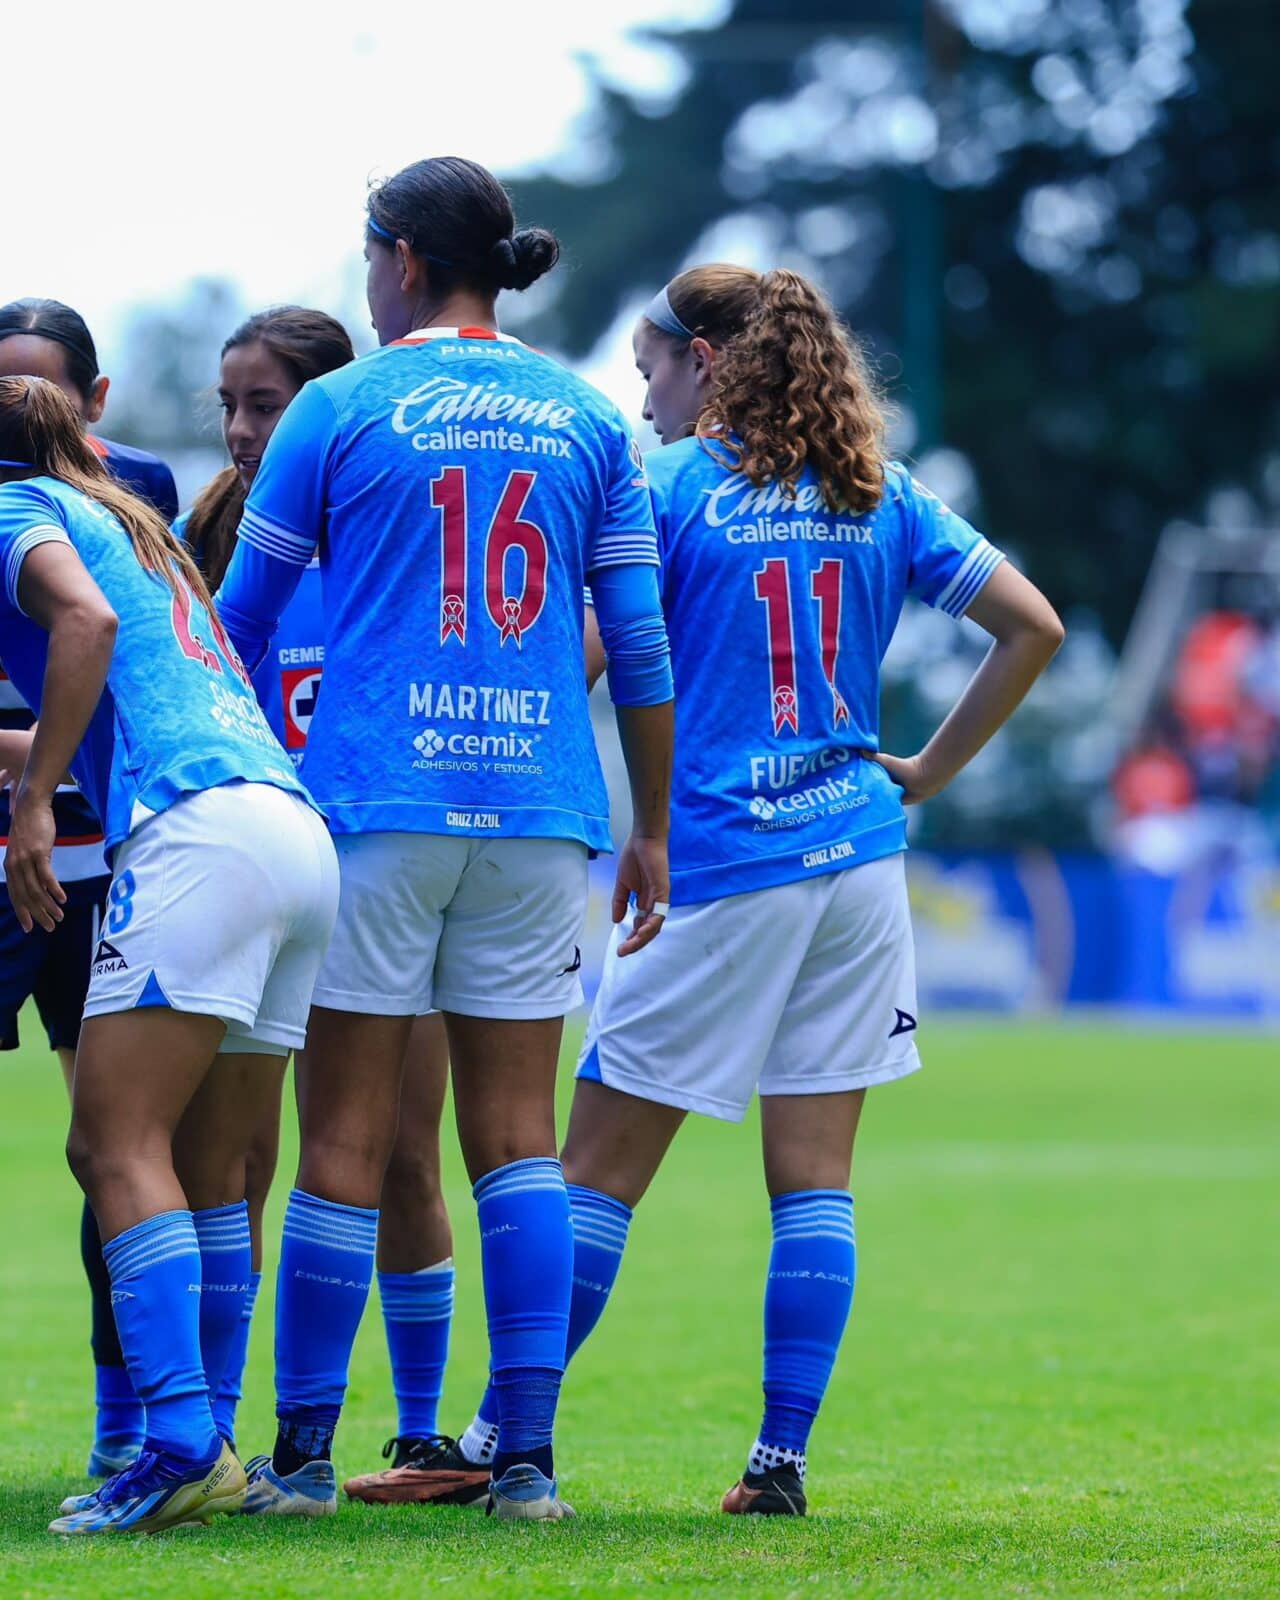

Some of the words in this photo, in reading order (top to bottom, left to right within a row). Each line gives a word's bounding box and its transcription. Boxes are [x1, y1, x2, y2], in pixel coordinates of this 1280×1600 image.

[441, 345, 520, 359] PIRMA
[389, 375, 576, 434] Caliente
[411, 425, 573, 459] caliente.mx
[725, 517, 874, 545] caliente.mx
[430, 465, 549, 648] 16
[278, 645, 325, 665] CEME
[753, 557, 849, 736] 11
[409, 682, 551, 726] MARTINEZ
[447, 731, 534, 758] cemix
[411, 759, 479, 772] ADHESIVOS
[483, 763, 490, 772] Y
[493, 763, 544, 775] ESTUCOS
[775, 776, 859, 813] cemix
[446, 811, 472, 827] CRUZ
[473, 813, 501, 828] AZUL
[753, 810, 817, 833] ADHESIVOS
[818, 808, 826, 817] Y
[827, 793, 871, 815] ESTUCOS
[802, 848, 831, 868] CRUZ
[829, 840, 856, 861] AZUL
